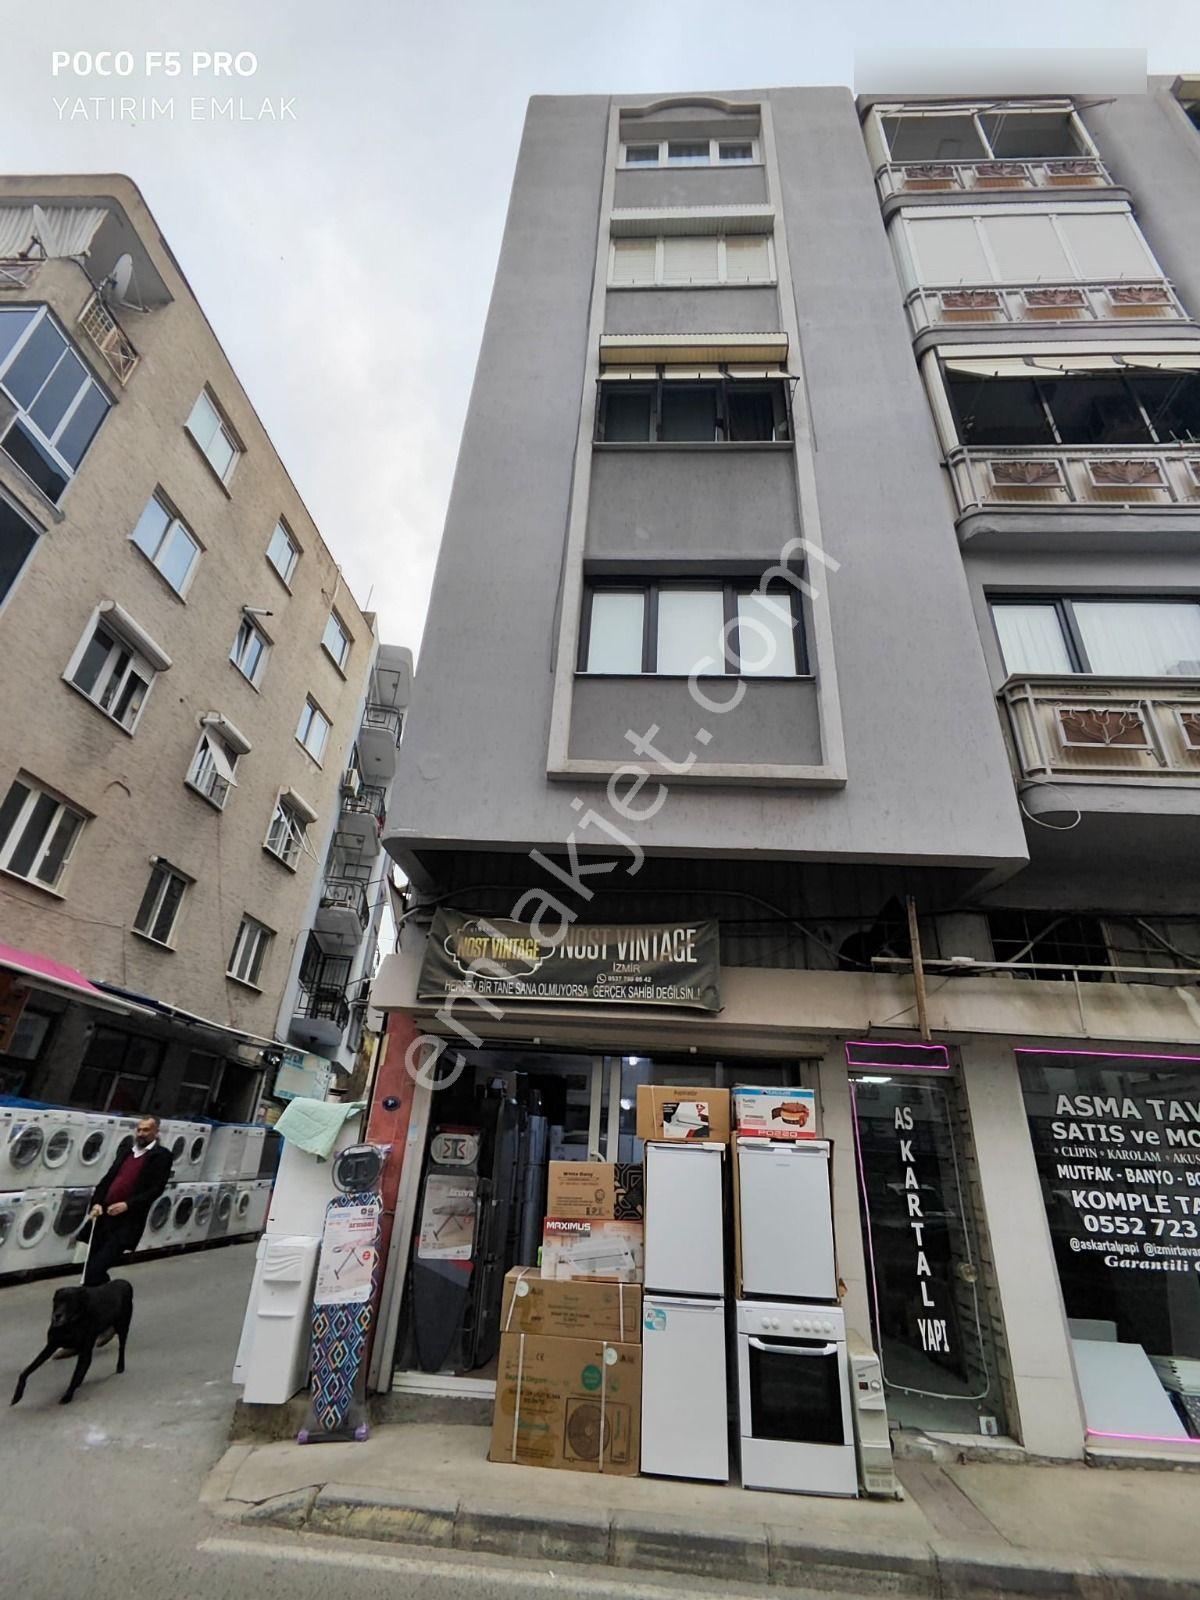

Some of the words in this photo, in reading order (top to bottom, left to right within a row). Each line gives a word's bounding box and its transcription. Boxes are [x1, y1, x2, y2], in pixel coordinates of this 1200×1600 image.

[492, 937, 541, 960] VINTAGE
[560, 927, 609, 959] NOST
[616, 928, 698, 963] VINTAGE
[612, 961, 641, 973] İZMİR
[478, 979, 492, 993] BİR
[493, 981, 514, 995] TANE
[515, 982, 537, 996] SANA
[538, 983, 588, 997] OLMUYORSA
[593, 985, 626, 999] GERÇEK
[627, 984, 654, 999] SAHİBİ
[894, 1107, 913, 1130] AS
[1056, 1094, 1142, 1120] ASMA
[1146, 1099, 1200, 1123] TAV
[1051, 1122, 1125, 1147] SATIŞ
[1130, 1130, 1160, 1146] ve
[1061, 1144, 1098, 1159] CLİPİN
[1107, 1148, 1162, 1162] KAROLAM
[1057, 1164, 1114, 1182] MUTFAK
[1126, 1169, 1174, 1186] BANYO
[1072, 1190, 1171, 1214] KOMPLE
[546, 1222, 591, 1231] MAXIMUS
[900, 1140, 935, 1307] KARTAL
[1084, 1215, 1147, 1235] 0552
[1150, 1218, 1198, 1238] 723
[1069, 1237, 1139, 1256] @askartalyapi
[1104, 1255, 1189, 1272] Garantili
[917, 1318, 950, 1353] YAPI
